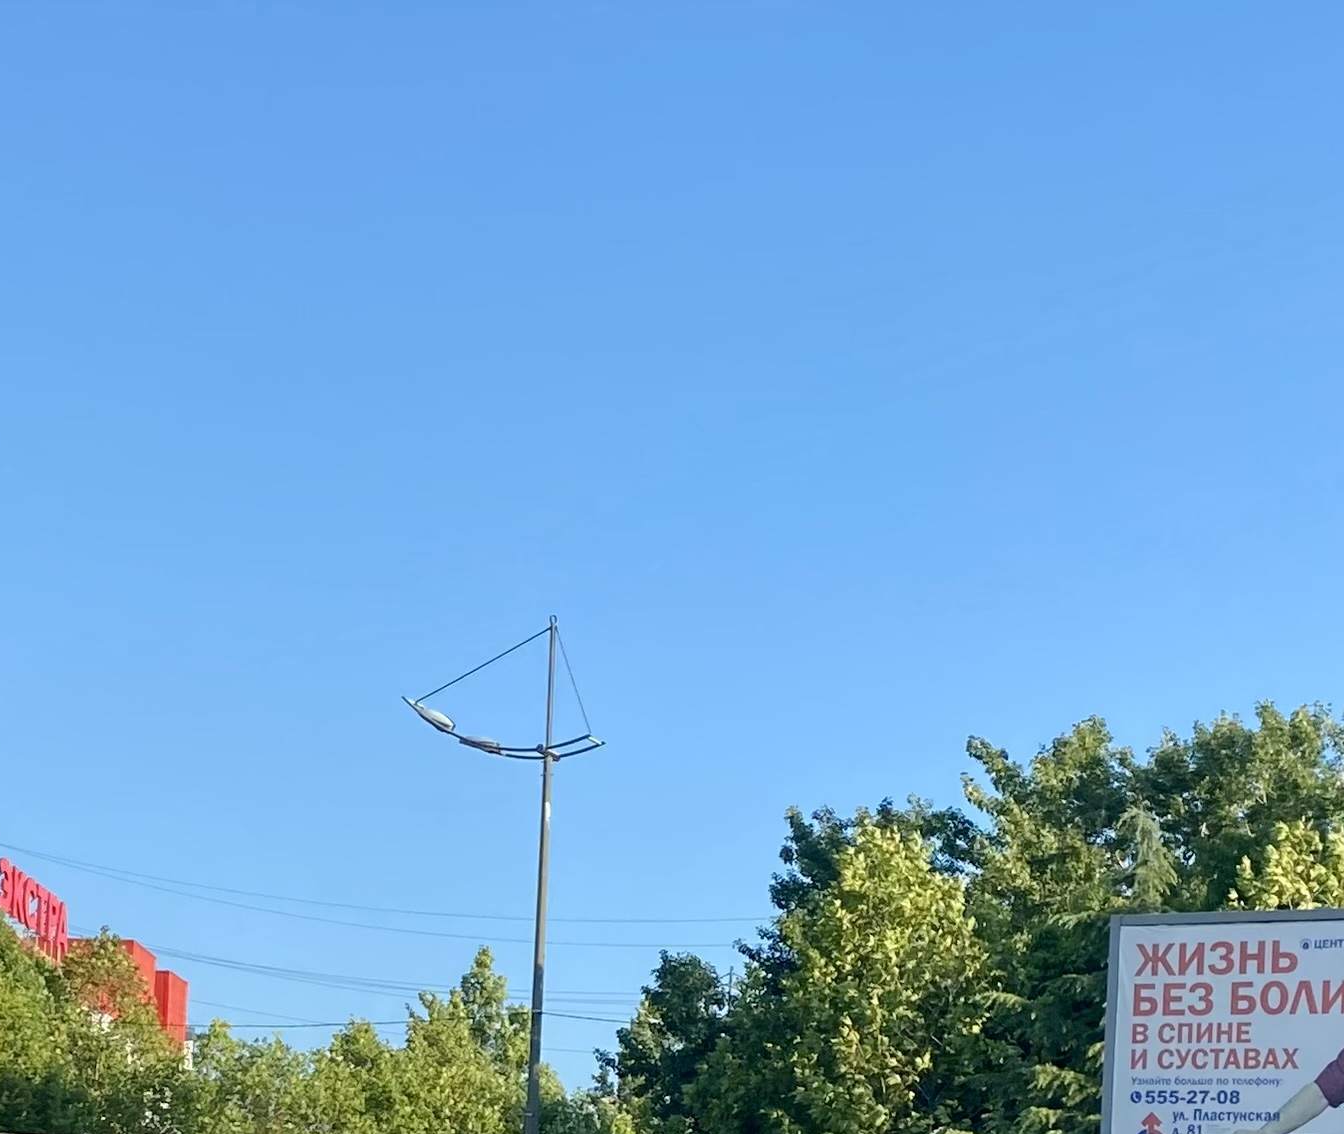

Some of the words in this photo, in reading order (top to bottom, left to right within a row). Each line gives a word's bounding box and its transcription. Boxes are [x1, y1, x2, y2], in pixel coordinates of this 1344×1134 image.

[1134, 940, 1299, 977] ЖИЗНЬ
[1132, 982, 1214, 1017] БЕЗ
[1131, 1023, 1149, 1044] В
[1158, 1022, 1252, 1044] СПИНЕ
[1130, 1049, 1148, 1070] И
[1157, 1047, 1299, 1070] СУСТАВАХ
[1131, 1076, 1172, 1086] Узнайте
[1174, 1076, 1214, 1086] больше
[1216, 1078, 1229, 1086] по
[1145, 1090, 1241, 1105] 555-27-08
[1172, 1111, 1189, 1124] ул.
[1193, 1108, 1281, 1124] Пластунская
